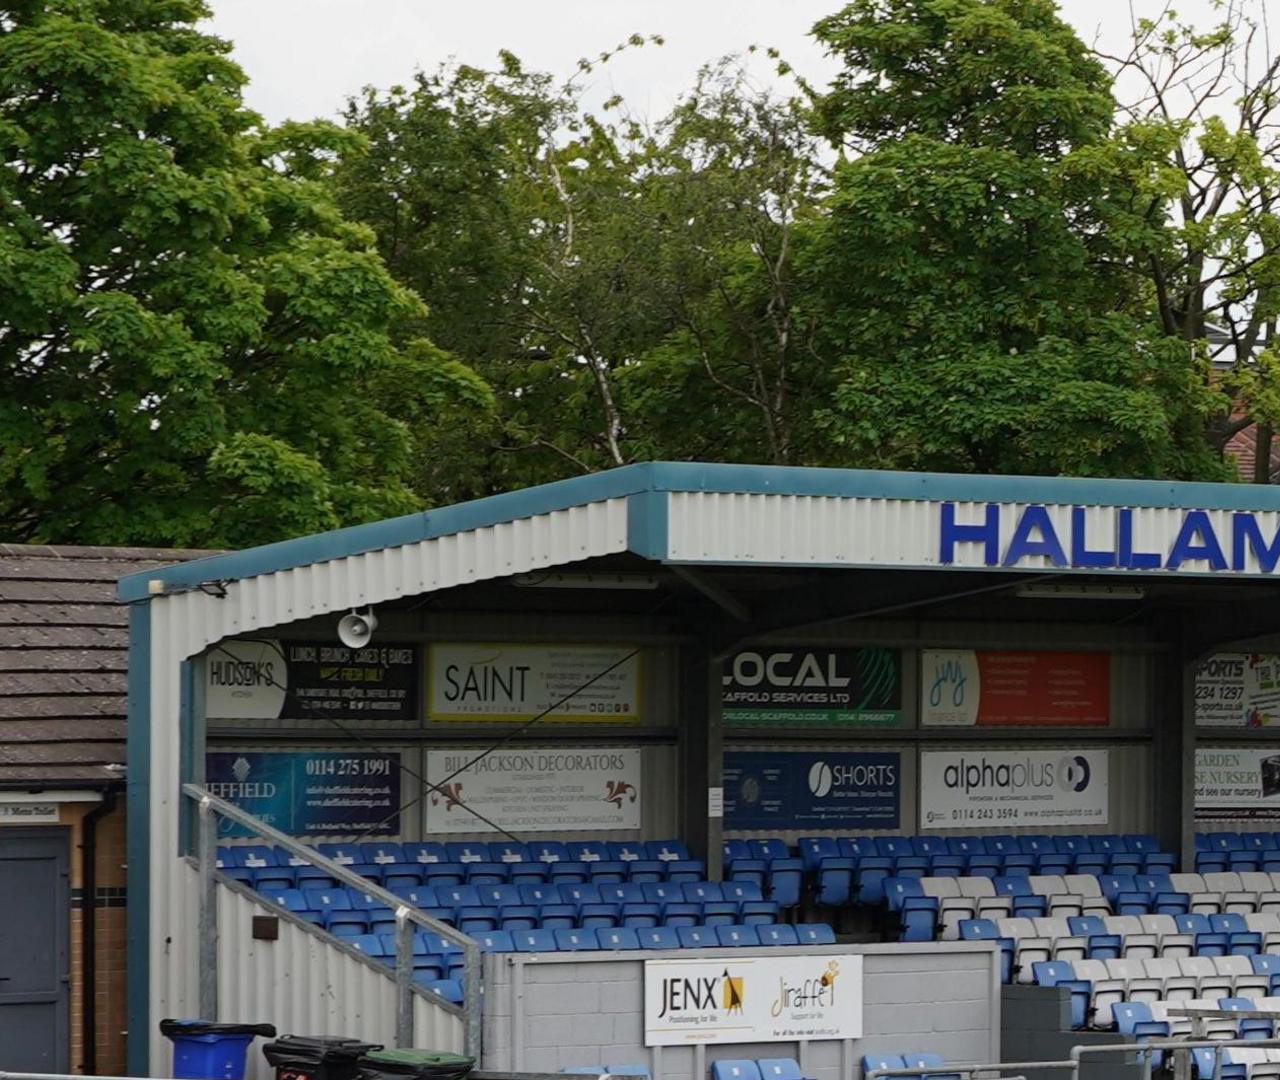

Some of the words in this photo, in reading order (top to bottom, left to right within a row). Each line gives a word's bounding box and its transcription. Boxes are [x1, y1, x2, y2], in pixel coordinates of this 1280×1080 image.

[210, 661, 274, 687] HUDSON'S
[444, 664, 531, 702] SAINT
[772, 693, 829, 704] SERVICES
[830, 694, 850, 703] LTD
[305, 759, 335, 775] 0114
[337, 759, 360, 775] 275
[363, 759, 391, 775] 1991
[444, 756, 473, 773] BILL
[474, 755, 534, 775] JACKSON
[537, 754, 625, 771] DECORATORS
[832, 764, 896, 786] SHORTS
[944, 757, 1055, 795] alphaplus
[1209, 771, 1262, 784] NURSERY
[952, 809, 975, 820] 0114
[977, 808, 994, 819] 243
[996, 807, 1019, 819] 3594
[658, 976, 718, 1019] JENX
[668, 1015, 700, 1025] Positioning
